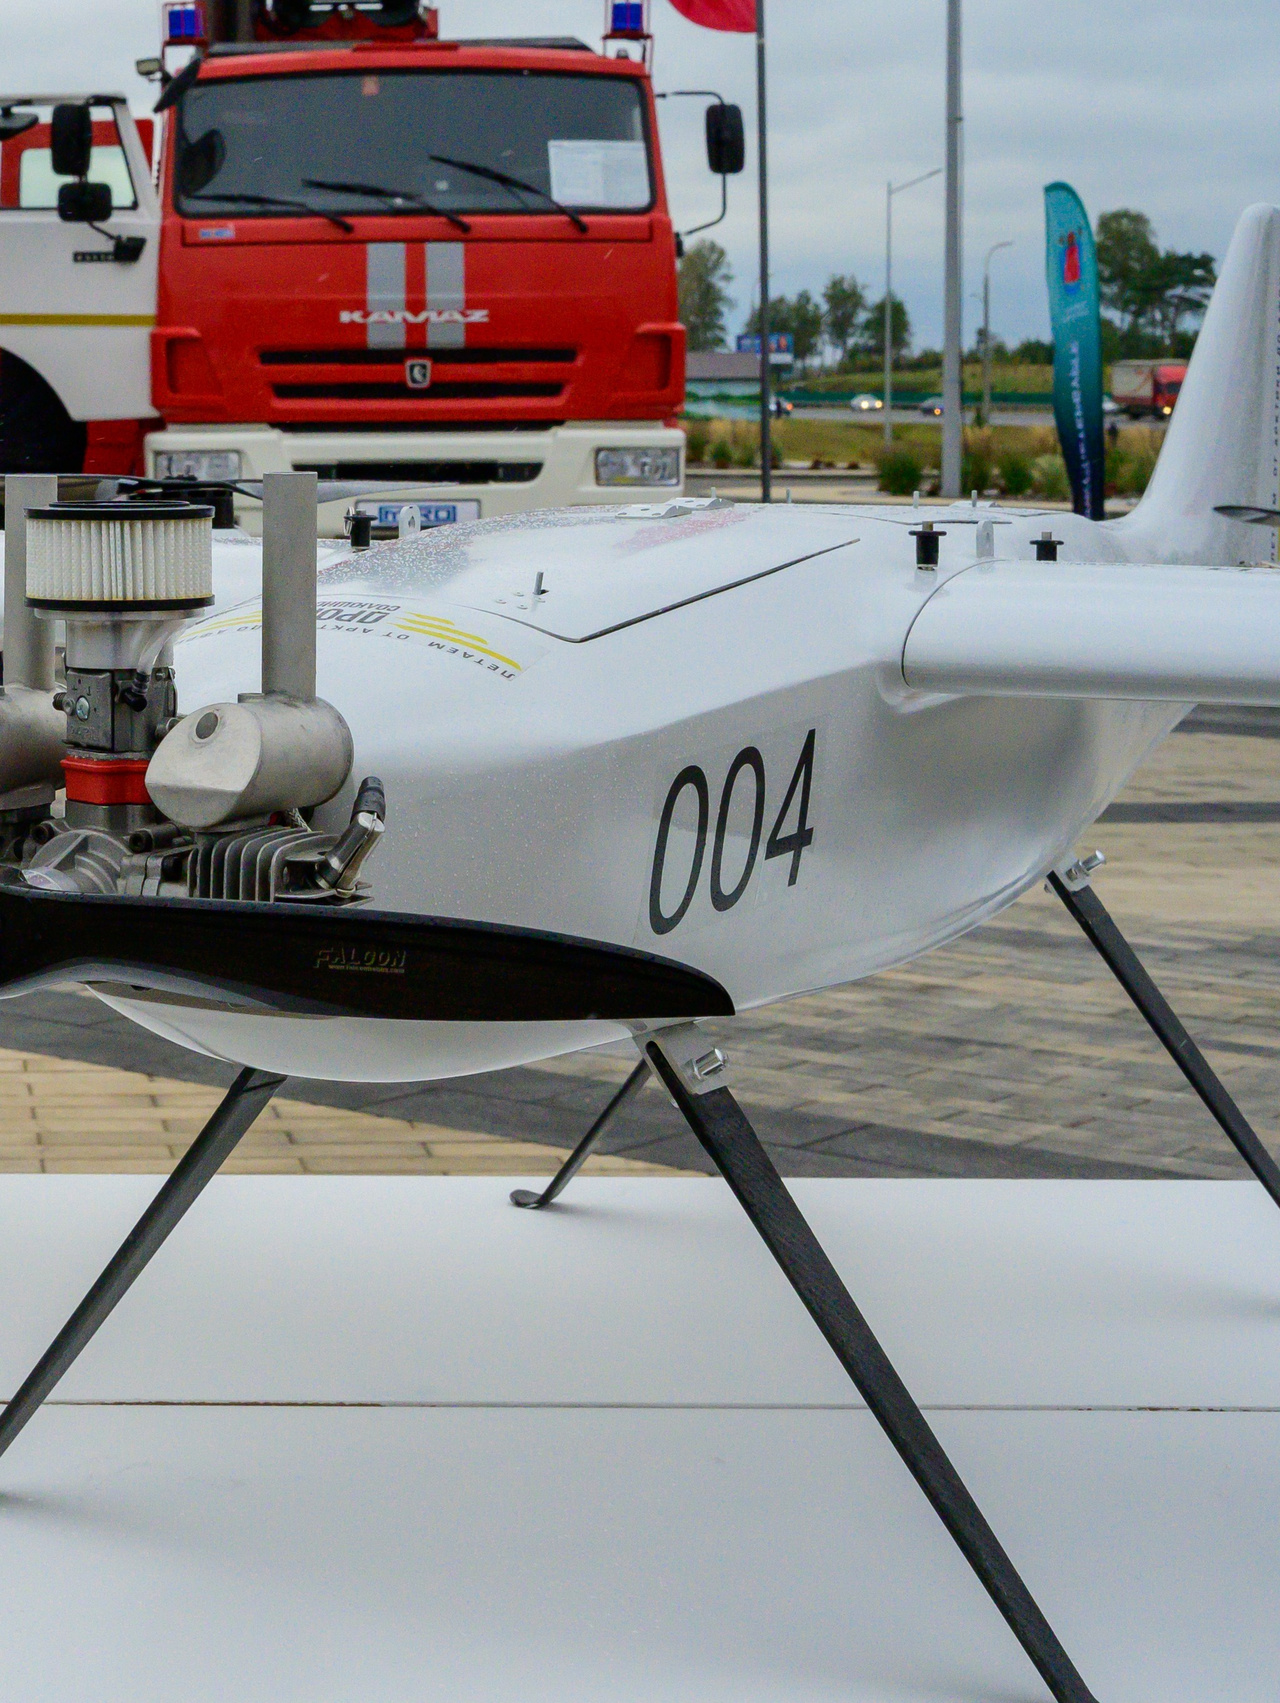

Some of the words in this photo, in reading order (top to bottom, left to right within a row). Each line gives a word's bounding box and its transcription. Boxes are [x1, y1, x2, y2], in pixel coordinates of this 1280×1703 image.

[339, 310, 489, 323] KAMAZ
[317, 624, 375, 634] АРКТ
[382, 631, 410, 640] ОТ
[428, 641, 516, 679] ЛЕТАЕМ
[649, 728, 816, 935] 004
[313, 947, 407, 968] FALCON
